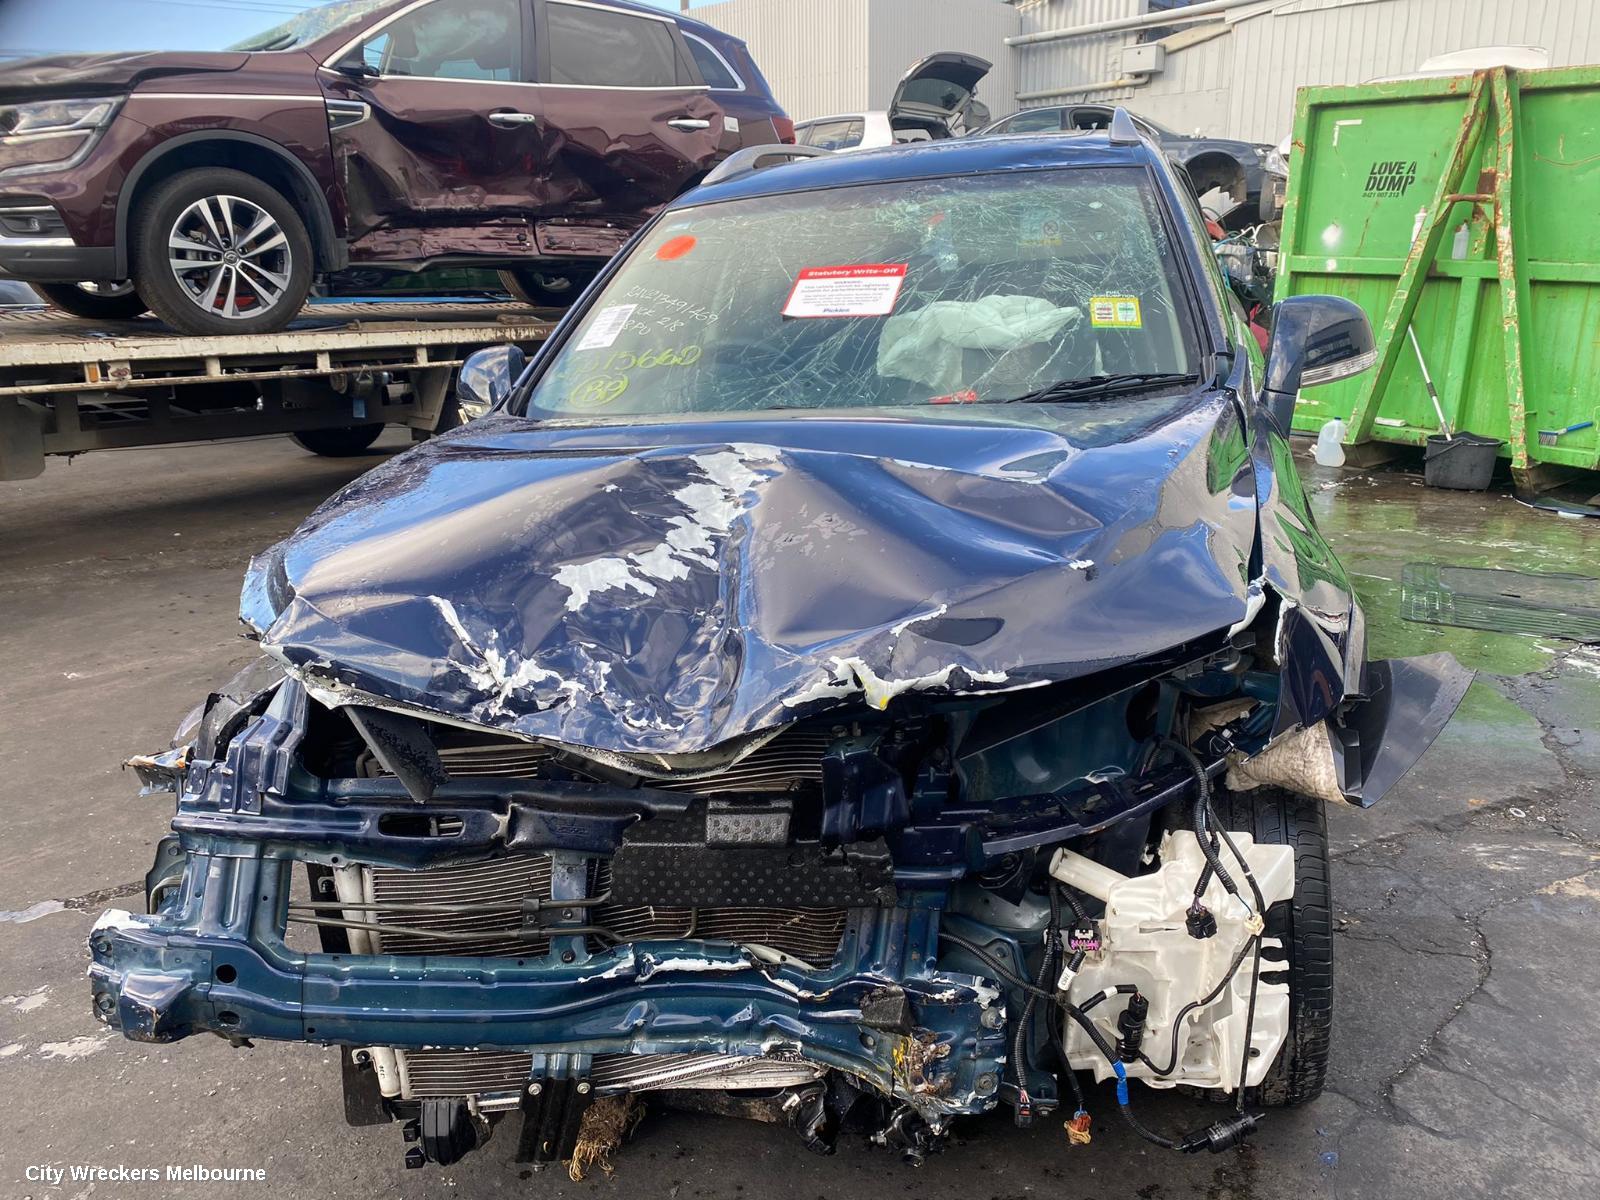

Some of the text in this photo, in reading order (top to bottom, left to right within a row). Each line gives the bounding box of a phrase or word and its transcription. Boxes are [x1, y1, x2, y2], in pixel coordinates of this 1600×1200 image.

[1370, 161, 1417, 175] LOVE A
[1365, 175, 1415, 197] DUMP
[853, 267, 899, 275] Write-Off
